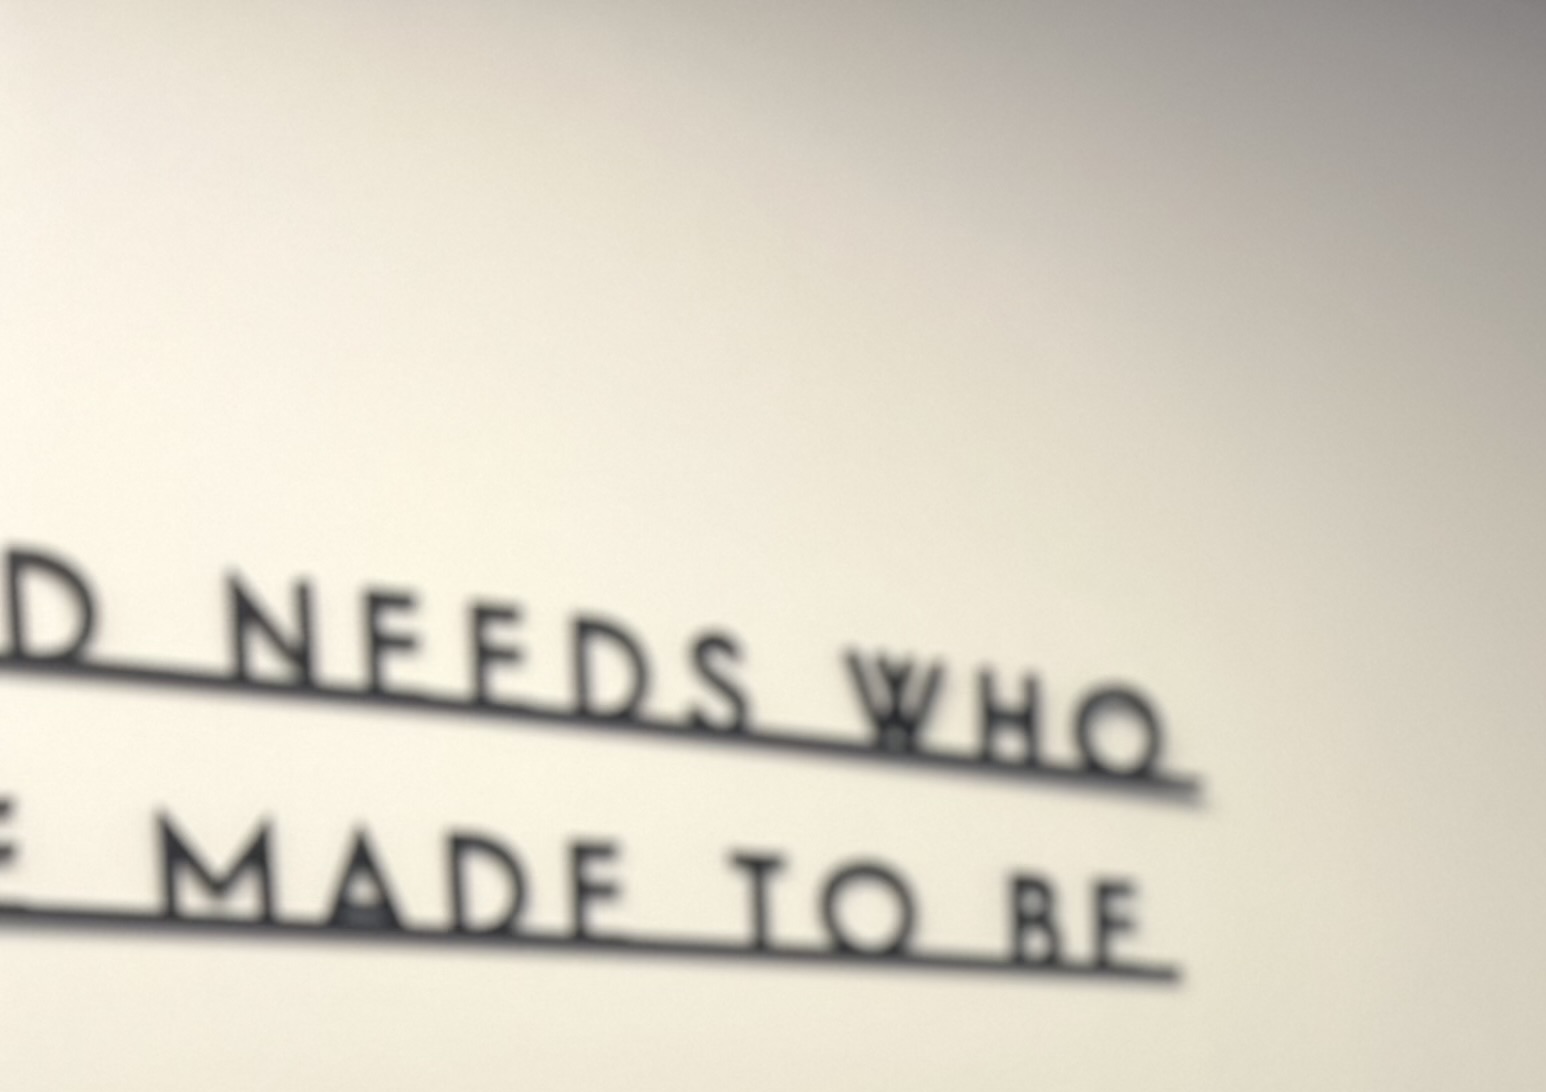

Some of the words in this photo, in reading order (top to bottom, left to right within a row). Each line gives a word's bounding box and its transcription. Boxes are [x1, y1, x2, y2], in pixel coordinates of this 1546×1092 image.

[224, 566, 749, 733] NEEDS
[841, 645, 1164, 777] WHO
[155, 802, 622, 938] MADE
[728, 846, 917, 957] TO
[1006, 868, 1139, 968] BE
